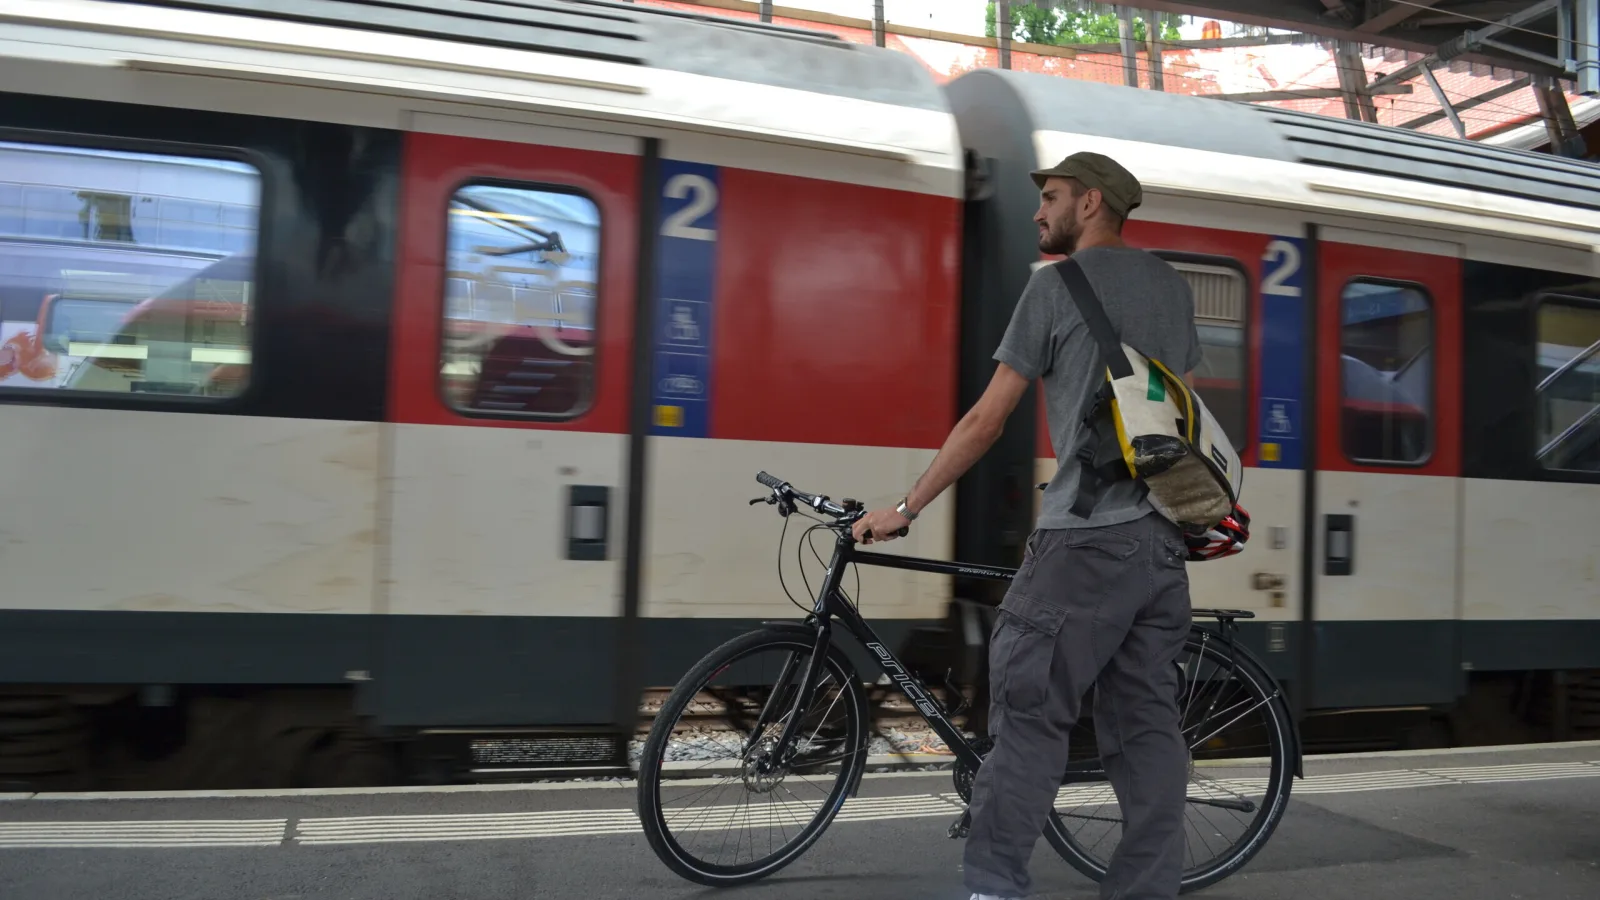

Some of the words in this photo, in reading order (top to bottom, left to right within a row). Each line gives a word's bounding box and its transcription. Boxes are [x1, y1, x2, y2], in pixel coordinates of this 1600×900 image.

[659, 172, 720, 242] 2
[1259, 239, 1303, 298] 2
[958, 567, 1001, 577] adventure
